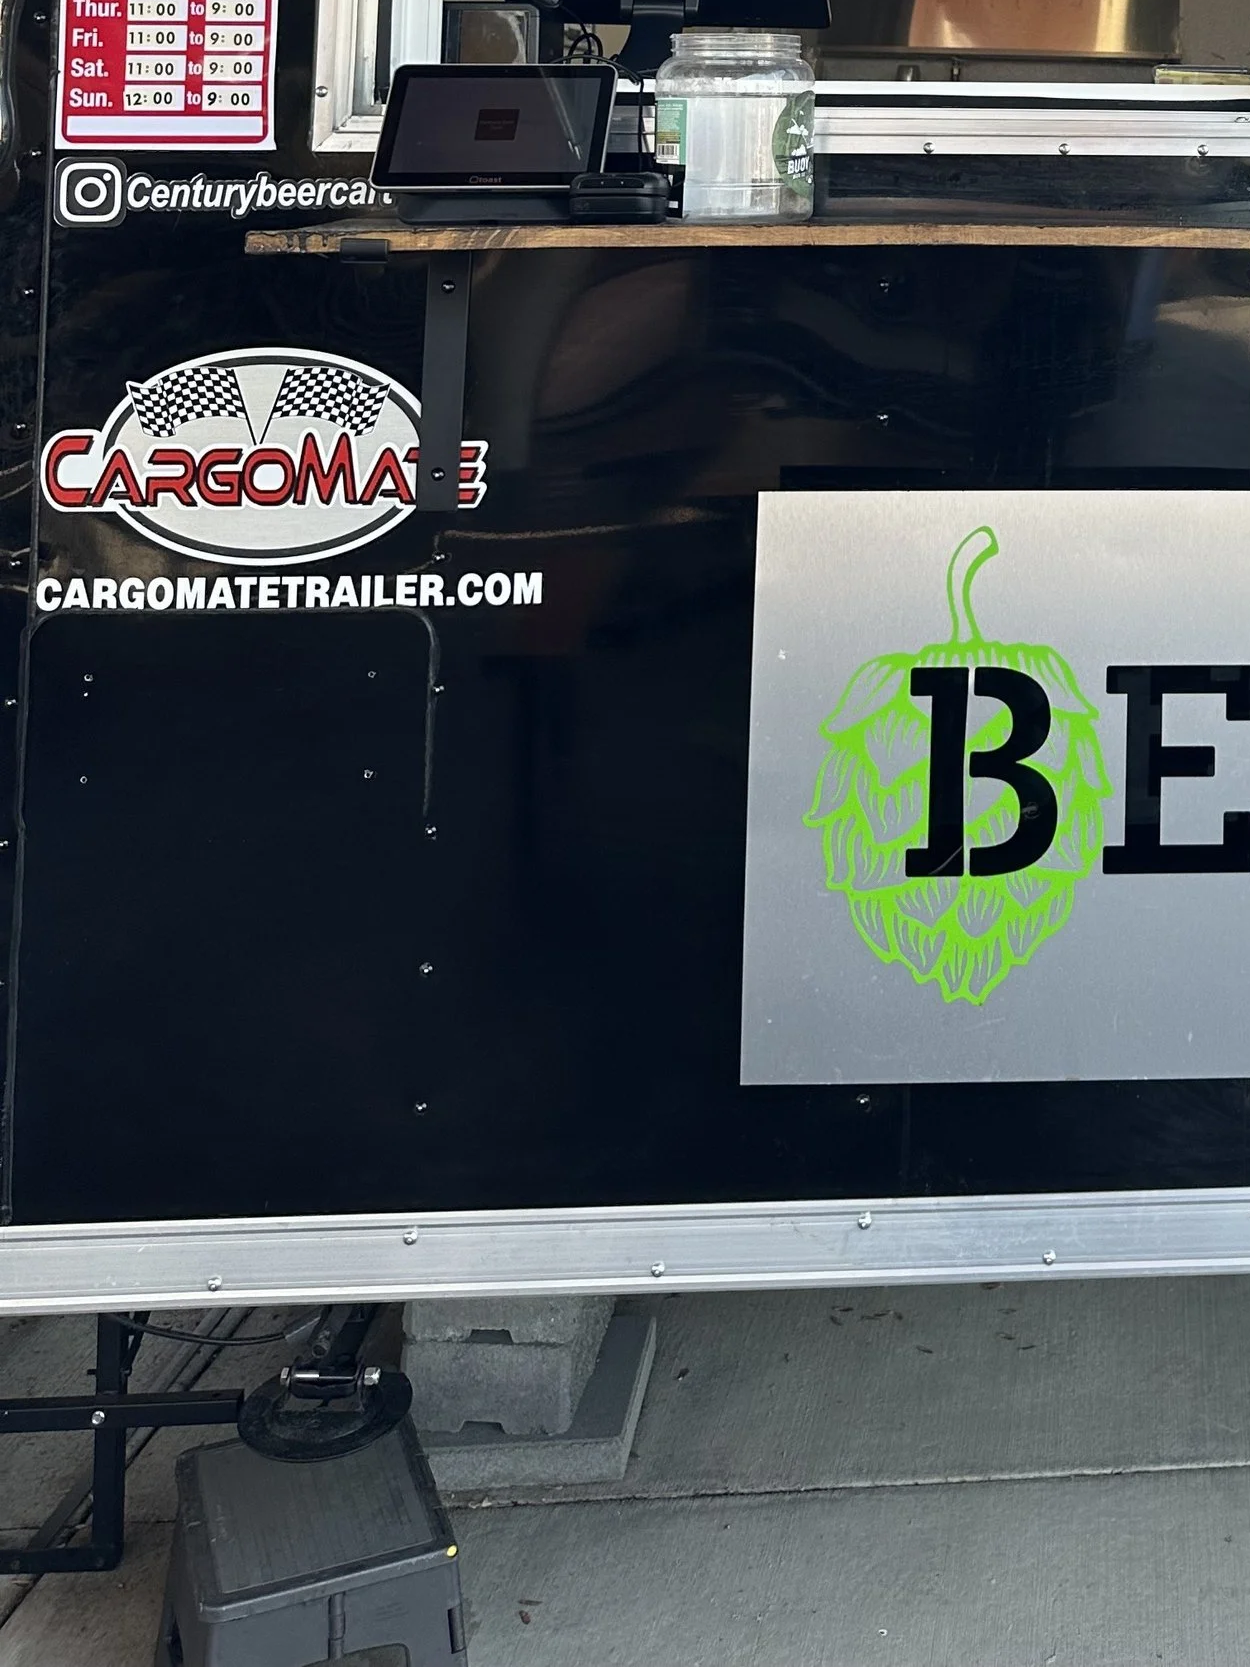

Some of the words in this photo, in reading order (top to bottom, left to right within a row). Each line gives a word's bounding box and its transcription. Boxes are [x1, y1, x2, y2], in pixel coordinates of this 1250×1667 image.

[190, 2, 204, 16] to
[72, 28, 103, 48] Fri.
[188, 32, 203, 45] to
[71, 58, 109, 78] Sat.
[188, 62, 202, 76] to
[70, 88, 113, 108] Sun.
[187, 91, 201, 106] to
[788, 156, 809, 174] BUOY
[36, 572, 543, 611] CARGOMATETRAILER.COM
